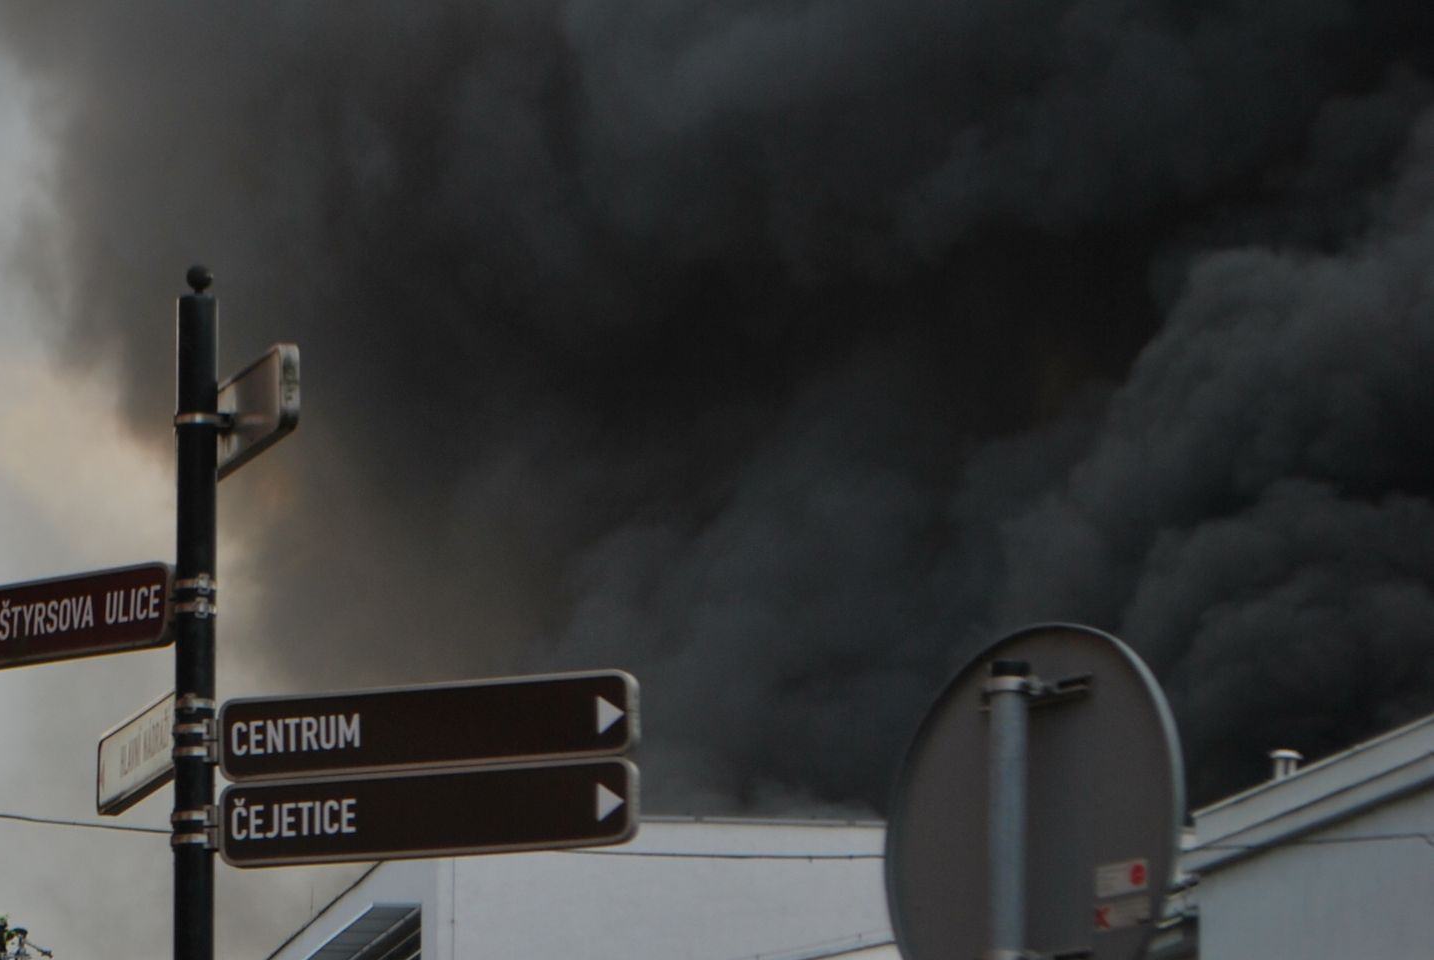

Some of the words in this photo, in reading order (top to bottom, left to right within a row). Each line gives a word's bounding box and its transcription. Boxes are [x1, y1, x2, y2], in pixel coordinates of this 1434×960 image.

[104, 584, 162, 625] ULICE
[230, 713, 361, 757] CENTRUM
[230, 797, 357, 842] ČEJETICE
